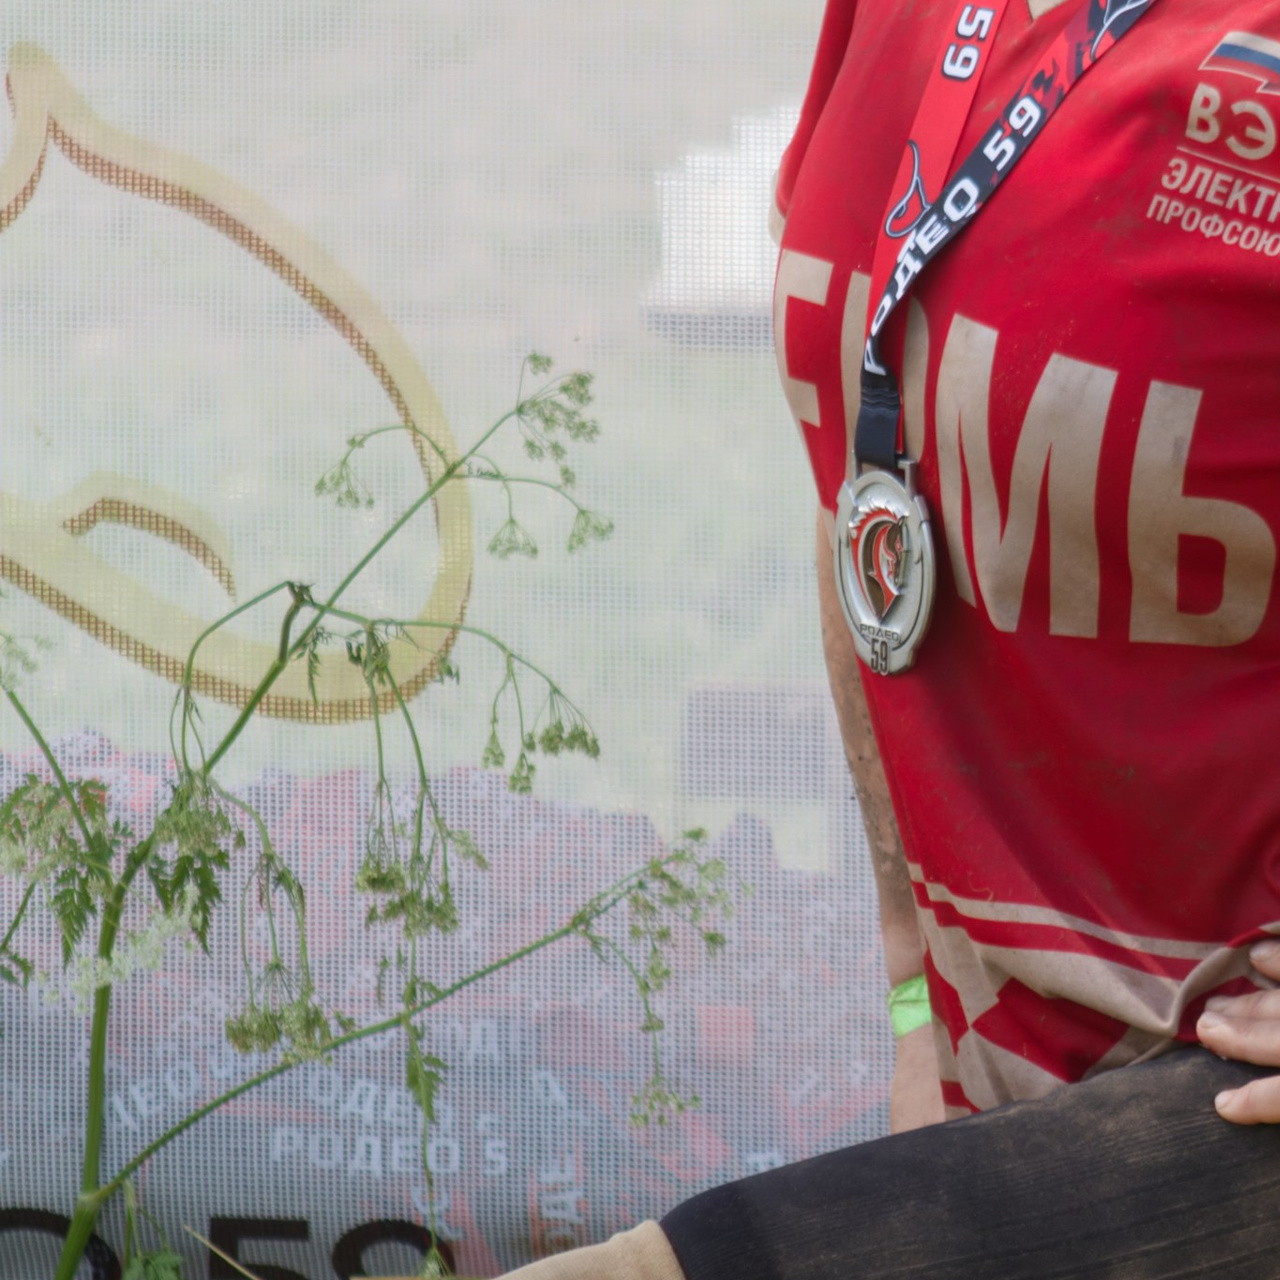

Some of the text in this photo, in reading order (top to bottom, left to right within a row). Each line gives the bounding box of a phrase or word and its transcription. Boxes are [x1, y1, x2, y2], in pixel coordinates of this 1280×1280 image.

[942, 3, 996, 81] 59
[863, 93, 1042, 377] РОДЕО 59
[870, 639, 889, 673] 59
